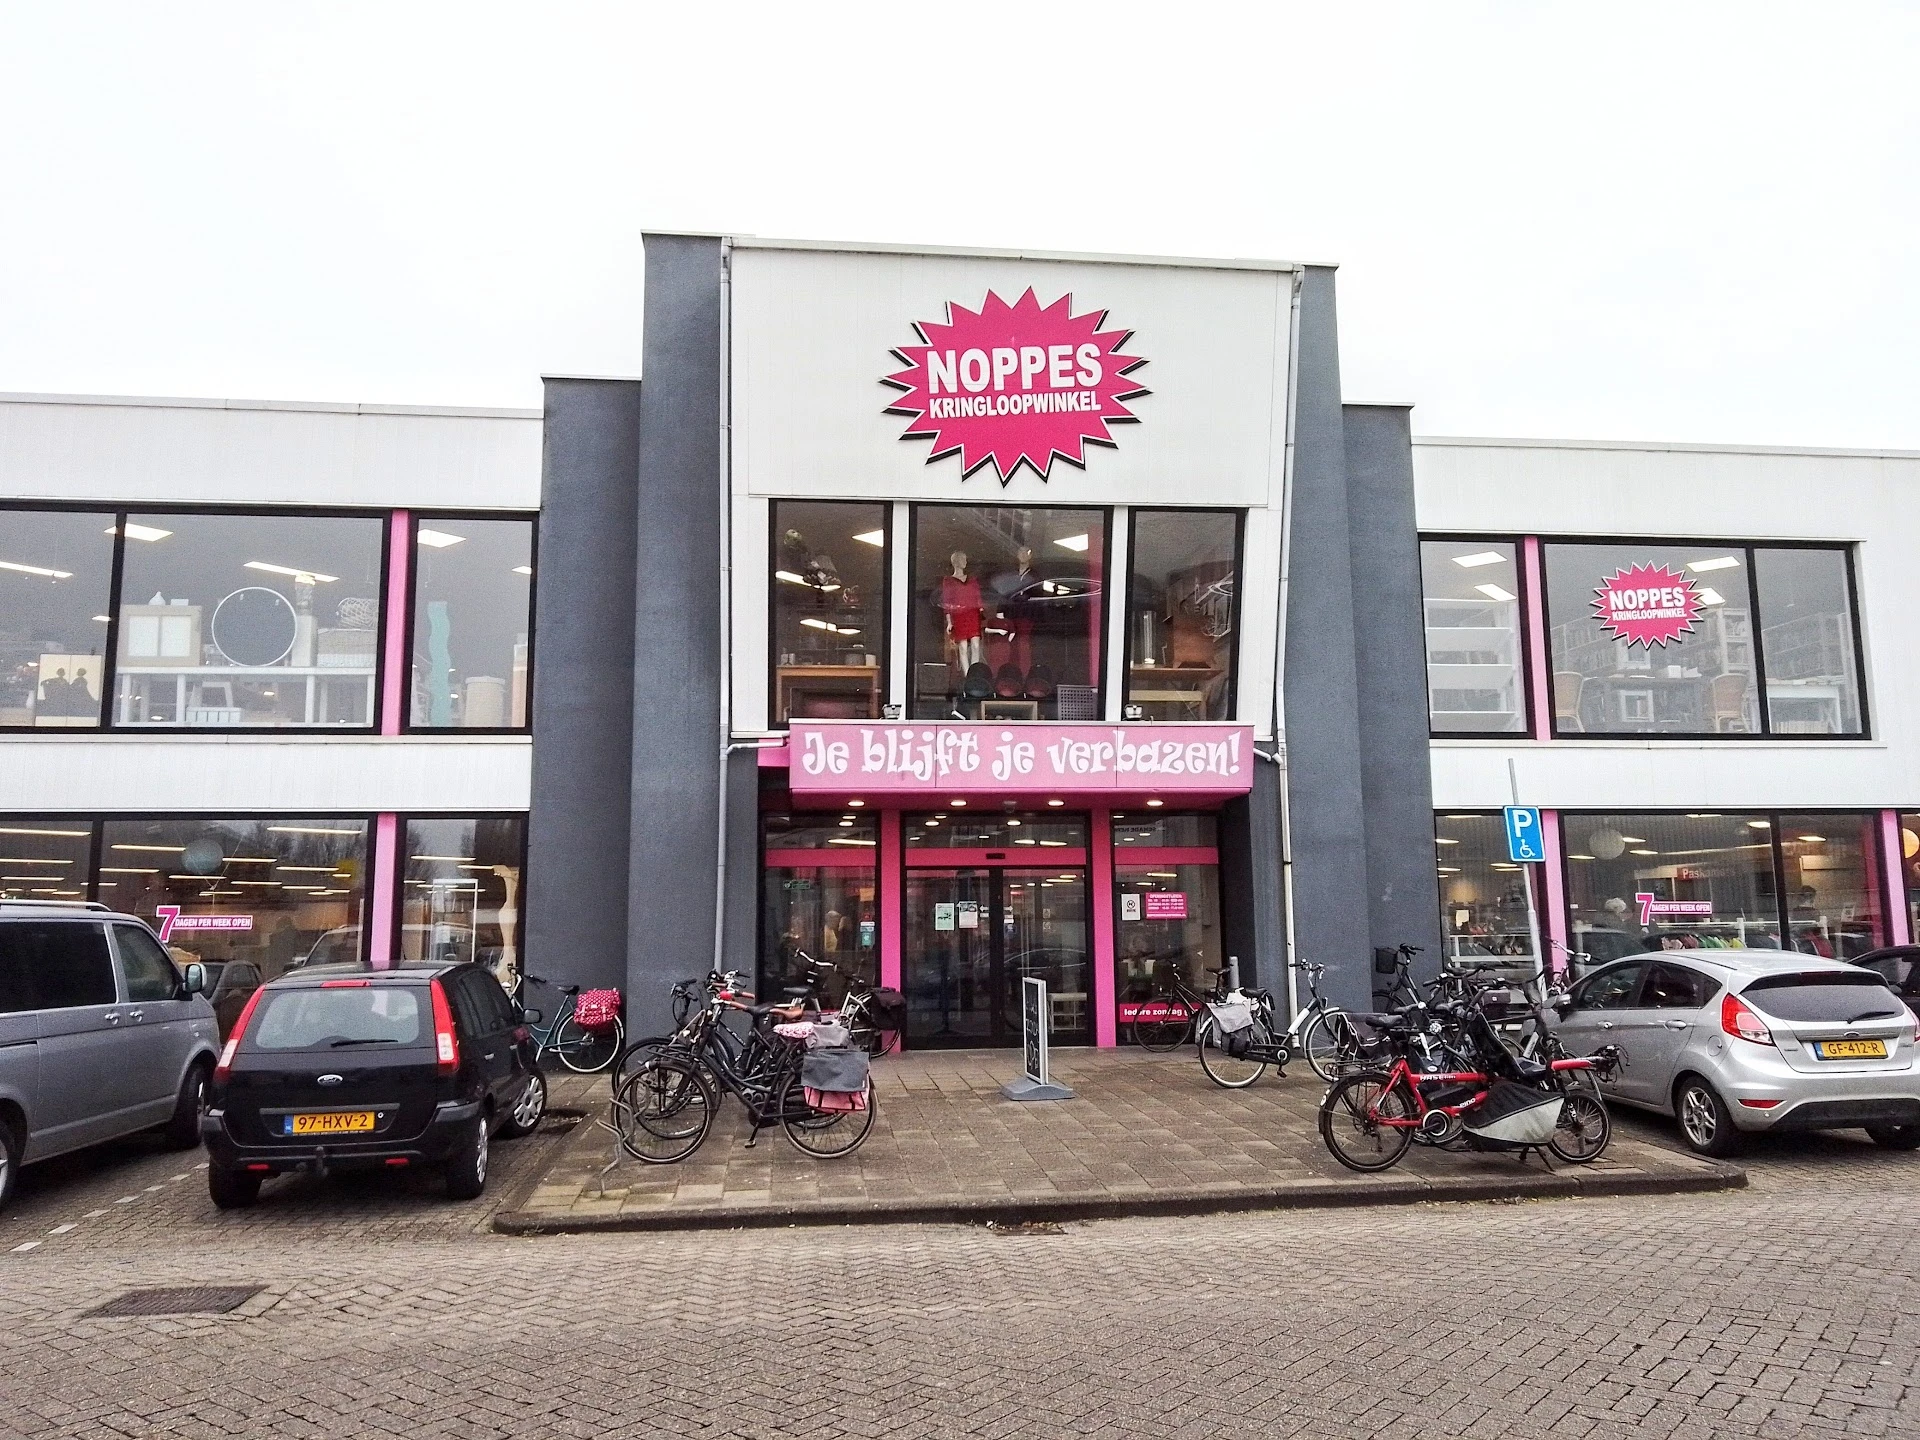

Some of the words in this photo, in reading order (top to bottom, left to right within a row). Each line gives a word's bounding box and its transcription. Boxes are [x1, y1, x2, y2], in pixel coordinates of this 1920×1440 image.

[926, 342, 1103, 394] NOPPES
[929, 390, 1102, 419] KRINGLOOPWINKEL
[1609, 587, 1686, 610] NOPPES
[1612, 608, 1687, 620] KRINGLOOPWINKEL
[802, 731, 850, 775] Je
[859, 728, 980, 781] blijft
[991, 731, 1035, 781] je
[1046, 729, 1241, 777] verbazen!
[1512, 809, 1533, 838] P
[1635, 892, 1654, 926] 7
[1696, 904, 1711, 912] OPEN
[157, 905, 181, 944] 7
[175, 918, 198, 927] DAGEN
[199, 918, 211, 927] PER
[213, 918, 232, 927] WEEK
[233, 918, 250, 927] OPEN
[1828, 1042, 1881, 1055] GF-412-R
[298, 1113, 368, 1130] 97-HXV-2
